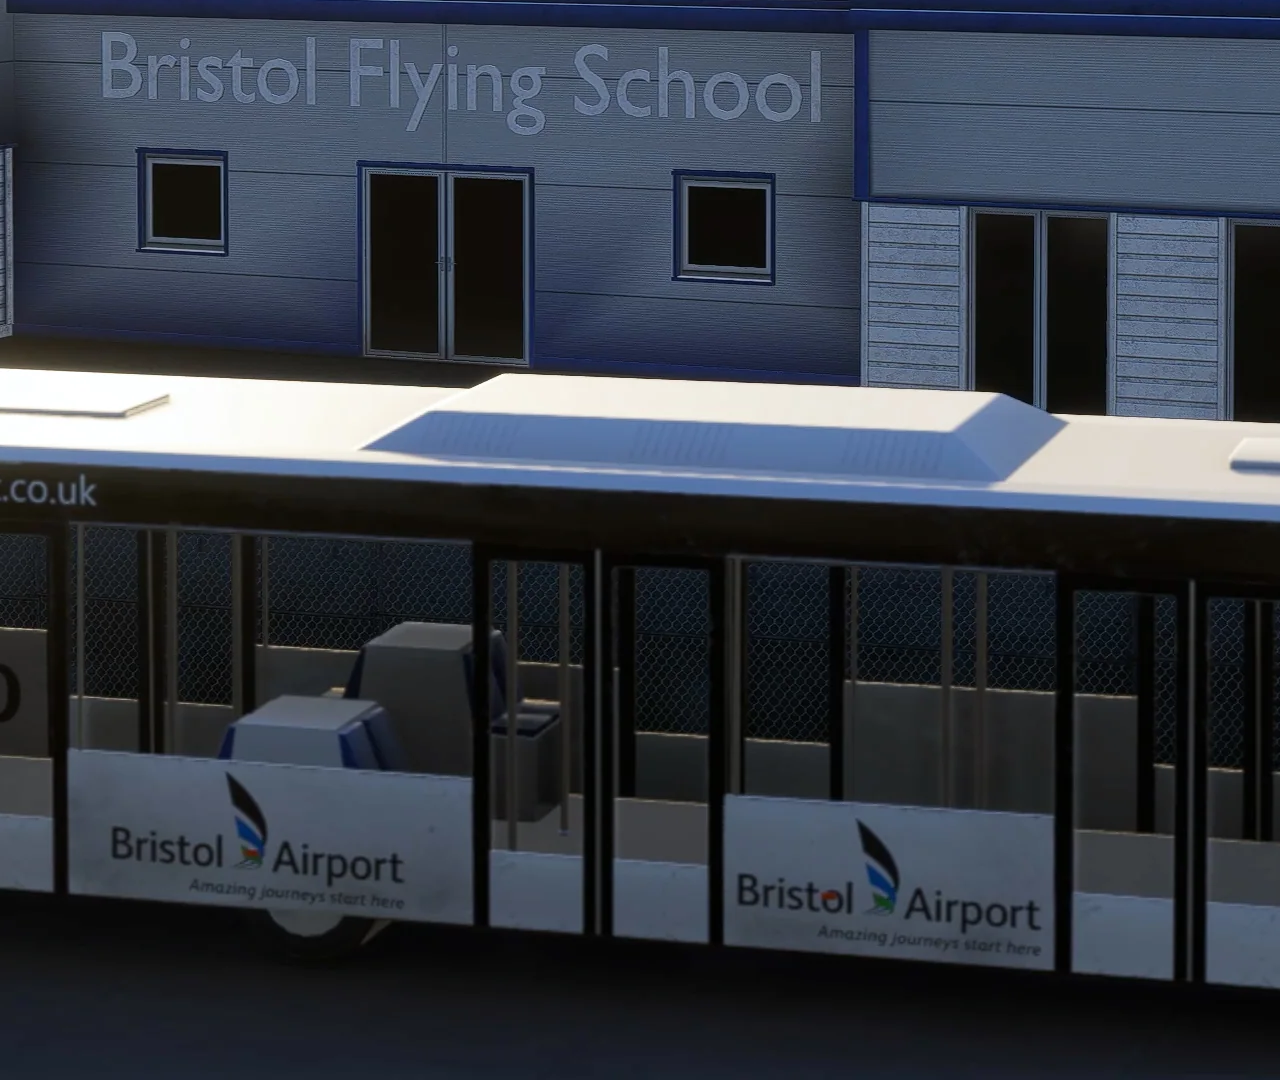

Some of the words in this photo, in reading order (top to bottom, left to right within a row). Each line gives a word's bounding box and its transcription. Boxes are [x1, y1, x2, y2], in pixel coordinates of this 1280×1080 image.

[100, 31, 317, 105] Bristol
[348, 37, 546, 136] Flying
[573, 43, 822, 123] School
[111, 826, 223, 868] Bristol
[272, 841, 405, 887] Airport
[188, 878, 256, 901] Amazing
[258, 885, 326, 905] journeys
[330, 891, 367, 906] start
[371, 893, 405, 910] here
[737, 873, 853, 914] Bristol
[904, 887, 1041, 934] Airport
[817, 925, 888, 946] Amazing
[889, 931, 960, 952] journeys
[964, 937, 1002, 953] start
[1006, 940, 1042, 957] here
